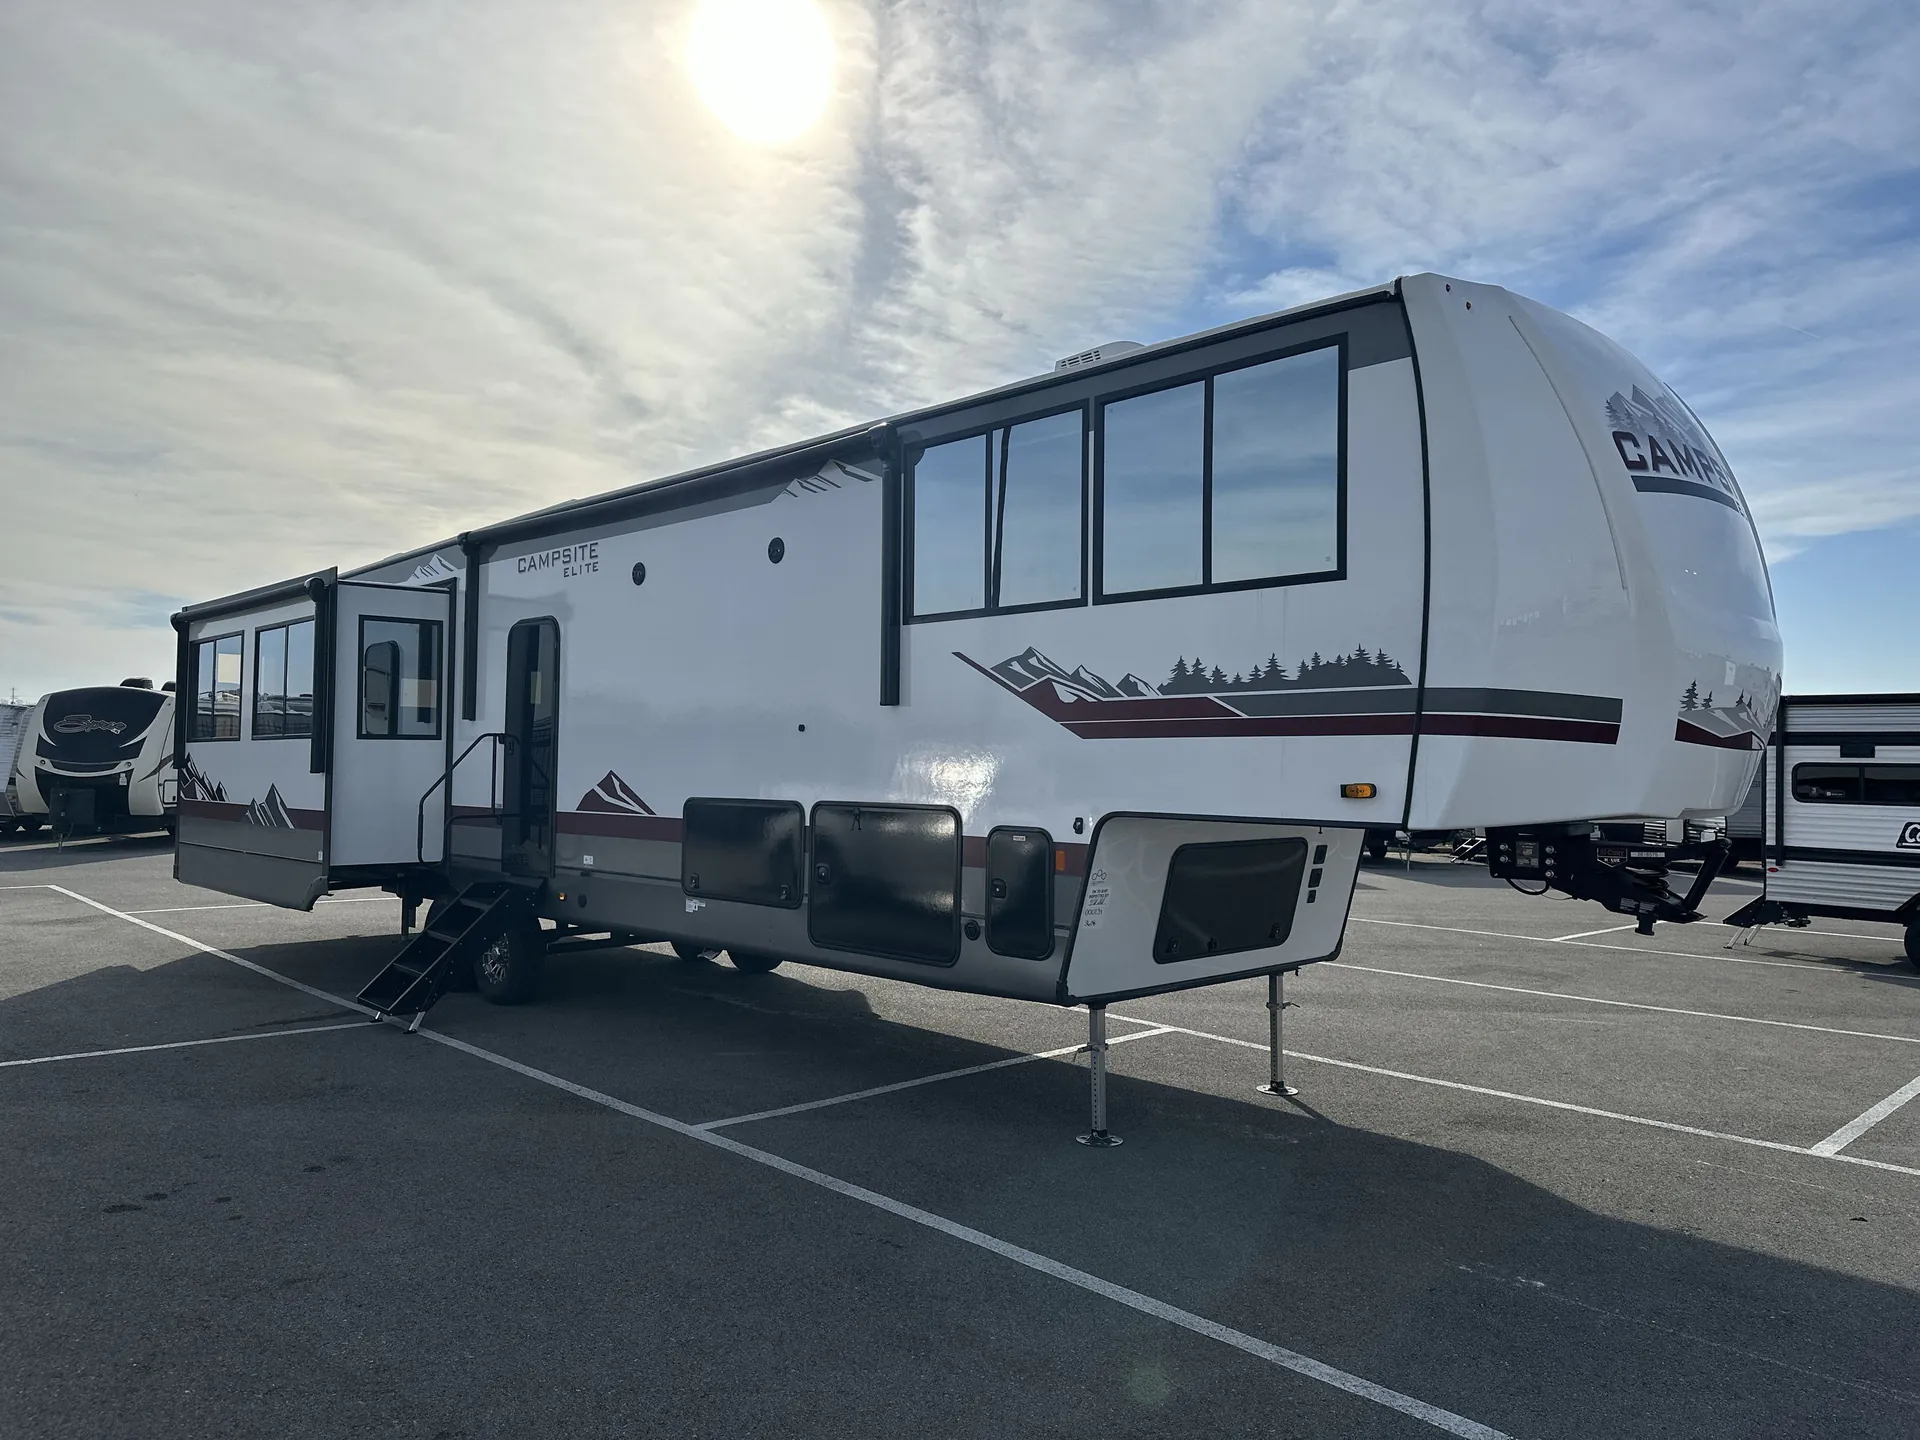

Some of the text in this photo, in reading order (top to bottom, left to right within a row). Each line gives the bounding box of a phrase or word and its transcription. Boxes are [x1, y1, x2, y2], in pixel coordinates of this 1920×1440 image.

[1612, 430, 1735, 495] CAMPS
[518, 542, 599, 573] CAMPSITE
[563, 561, 599, 578] ELITE
